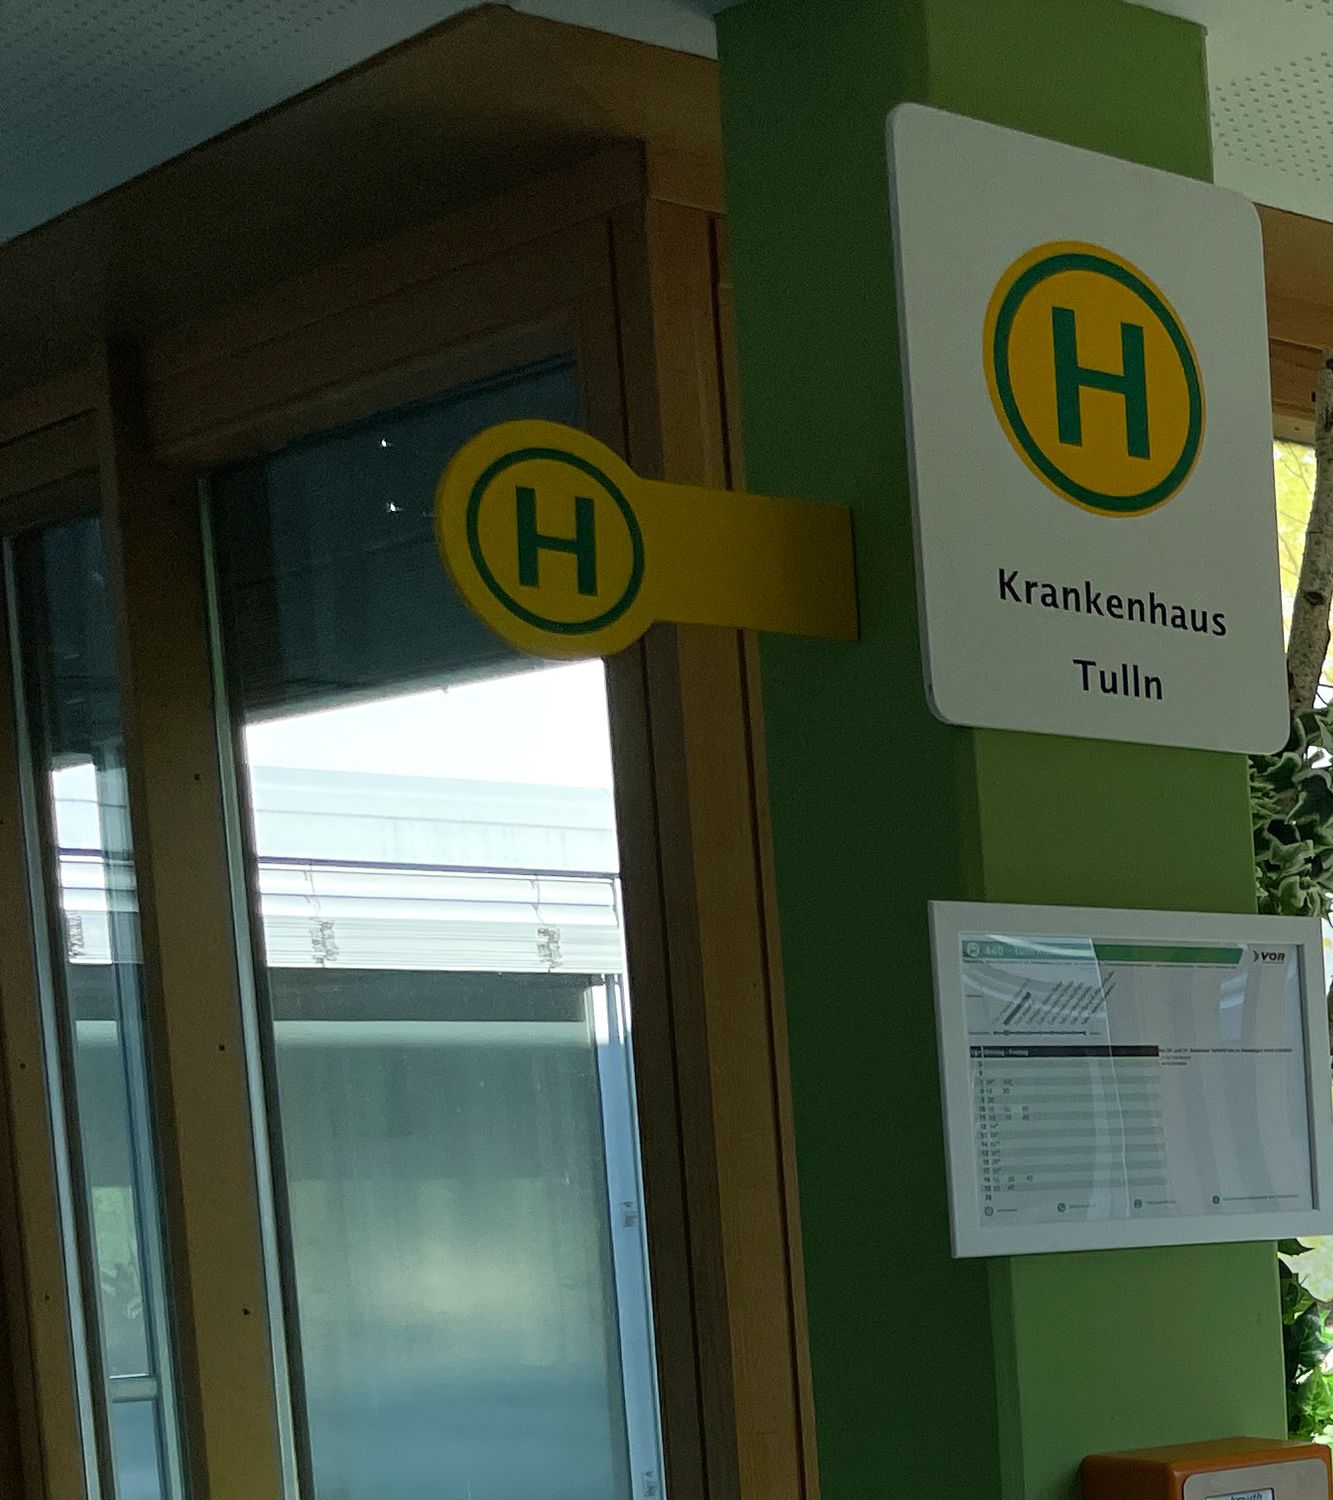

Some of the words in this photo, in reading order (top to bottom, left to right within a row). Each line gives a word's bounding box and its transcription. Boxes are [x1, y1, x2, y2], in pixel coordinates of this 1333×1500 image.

[1052, 306, 1149, 460] H
[516, 486, 597, 596] H
[999, 568, 1226, 636] Krankenhaus
[1073, 659, 1162, 700] Tulln
